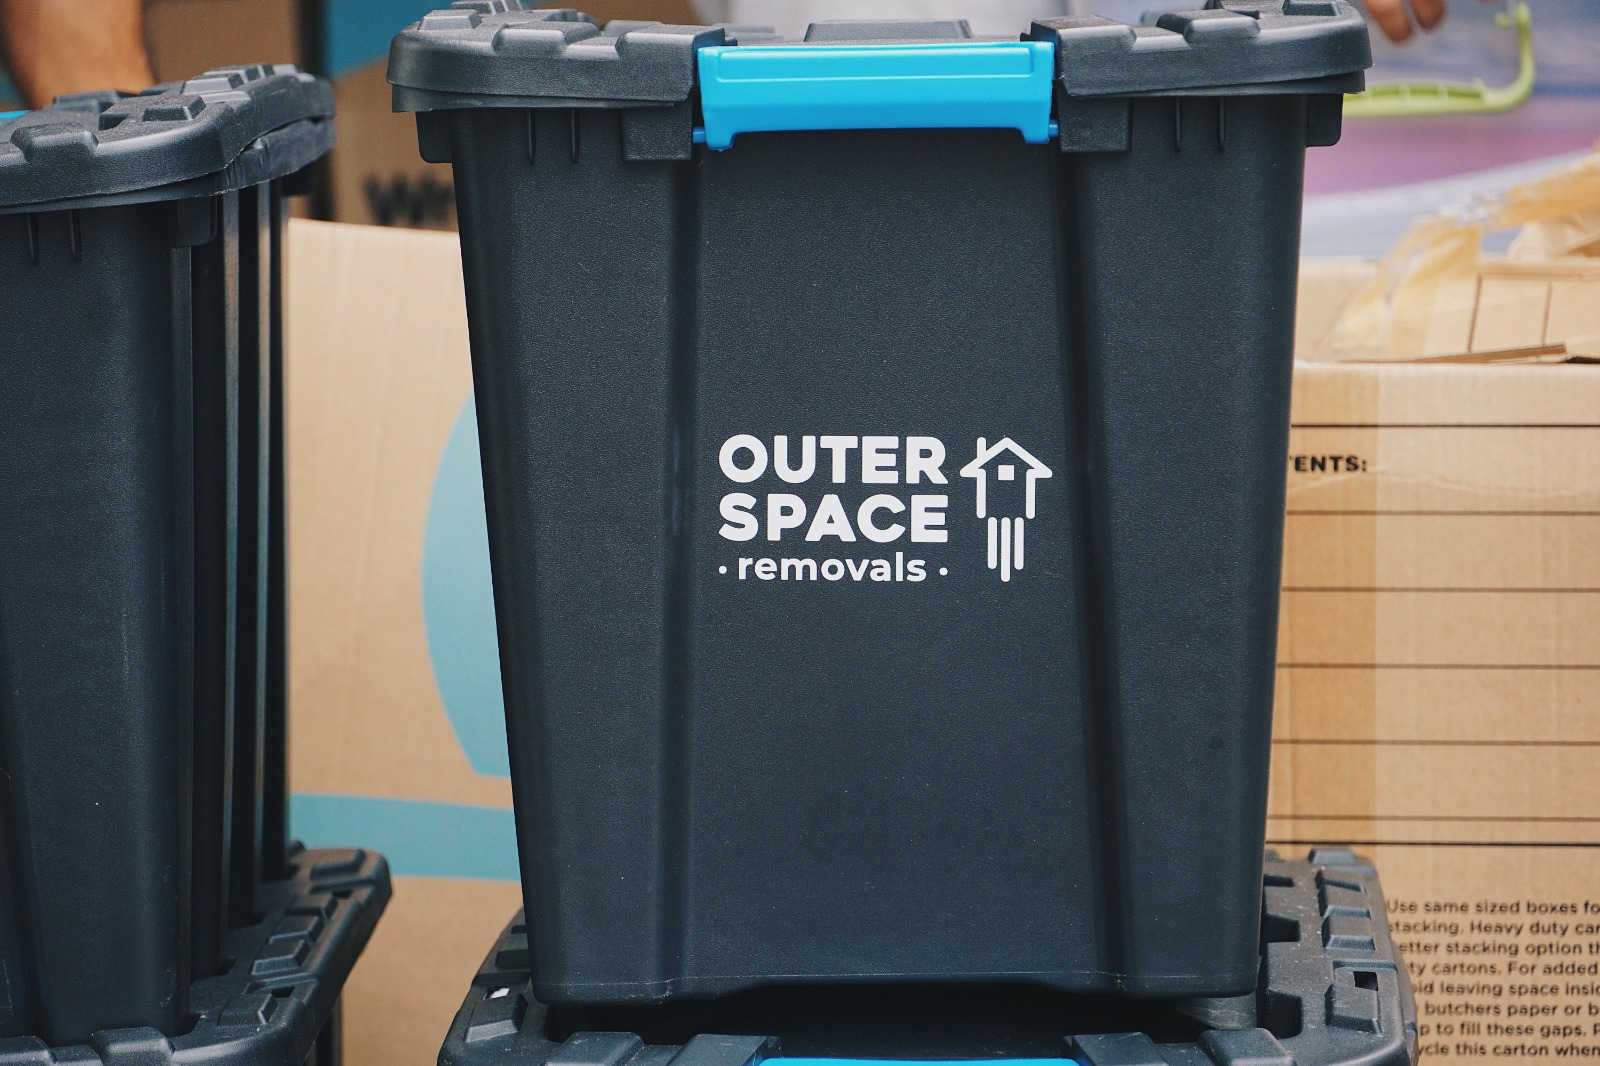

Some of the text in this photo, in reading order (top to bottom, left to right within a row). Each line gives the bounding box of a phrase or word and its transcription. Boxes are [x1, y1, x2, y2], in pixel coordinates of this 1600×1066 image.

[719, 434, 949, 484] OUTER
[1289, 454, 1367, 473] ENTS:
[718, 493, 949, 543] SPACE
[738, 552, 927, 582] removals
[1387, 900, 1418, 914] Use
[1424, 902, 1469, 914] same
[1475, 899, 1520, 914] sized
[1527, 899, 1578, 914] boxes
[1470, 921, 1523, 936] Heavy
[1530, 920, 1568, 936] duty
[1446, 941, 1519, 957] stacking
[1525, 941, 1582, 956] option
[1432, 961, 1502, 975] cartons.
[1508, 961, 1536, 975] For
[1543, 961, 1598, 975] added
[1441, 981, 1503, 998] leaving
[1509, 983, 1559, 998] space
[1425, 1001, 1501, 1016] butchers
[1508, 1003, 1558, 1018] paper
[1564, 1004, 1582, 1015] or
[1437, 1022, 1454, 1035] to
[1461, 1021, 1481, 1035] fill
[1487, 1022, 1534, 1036] these
[1540, 1024, 1587, 1039] gaps.
[1456, 1042, 1487, 1056] this
[1493, 1043, 1549, 1056] carton
